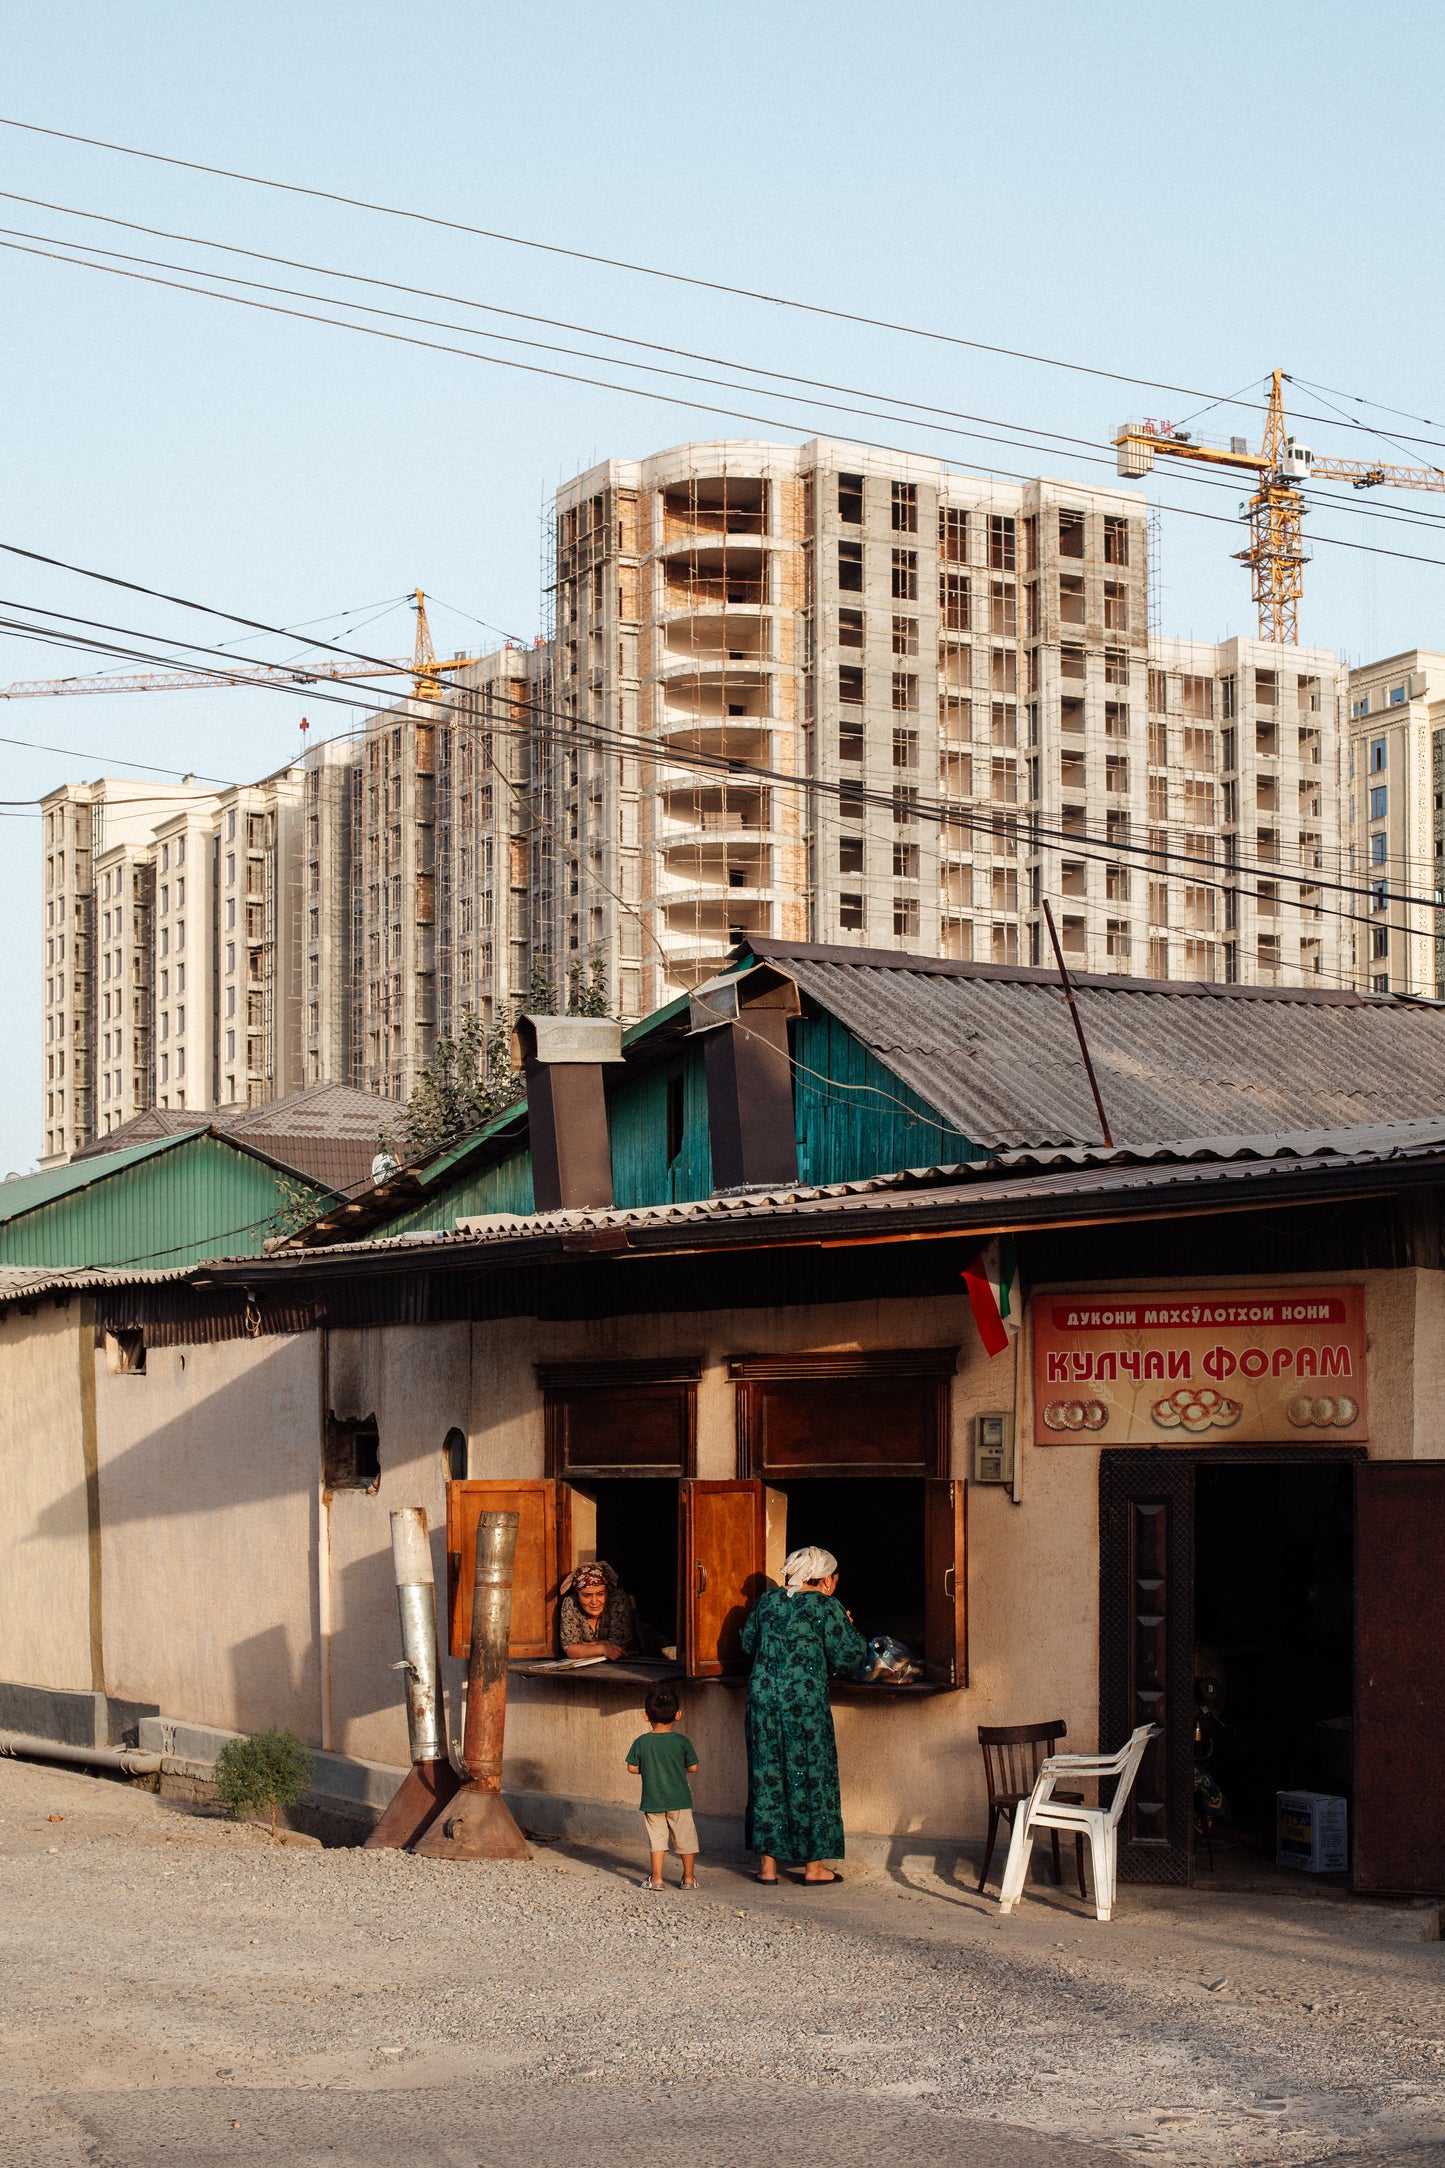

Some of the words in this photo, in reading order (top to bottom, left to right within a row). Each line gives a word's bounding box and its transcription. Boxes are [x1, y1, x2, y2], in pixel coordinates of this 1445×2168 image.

[1067, 1311, 1137, 1326] ДУКОНИ
[1281, 1305, 1330, 1320] НОНИ
[1047, 1349, 1192, 1383] КУЛЧАИ
[1202, 1344, 1353, 1382] ФОРАМ
